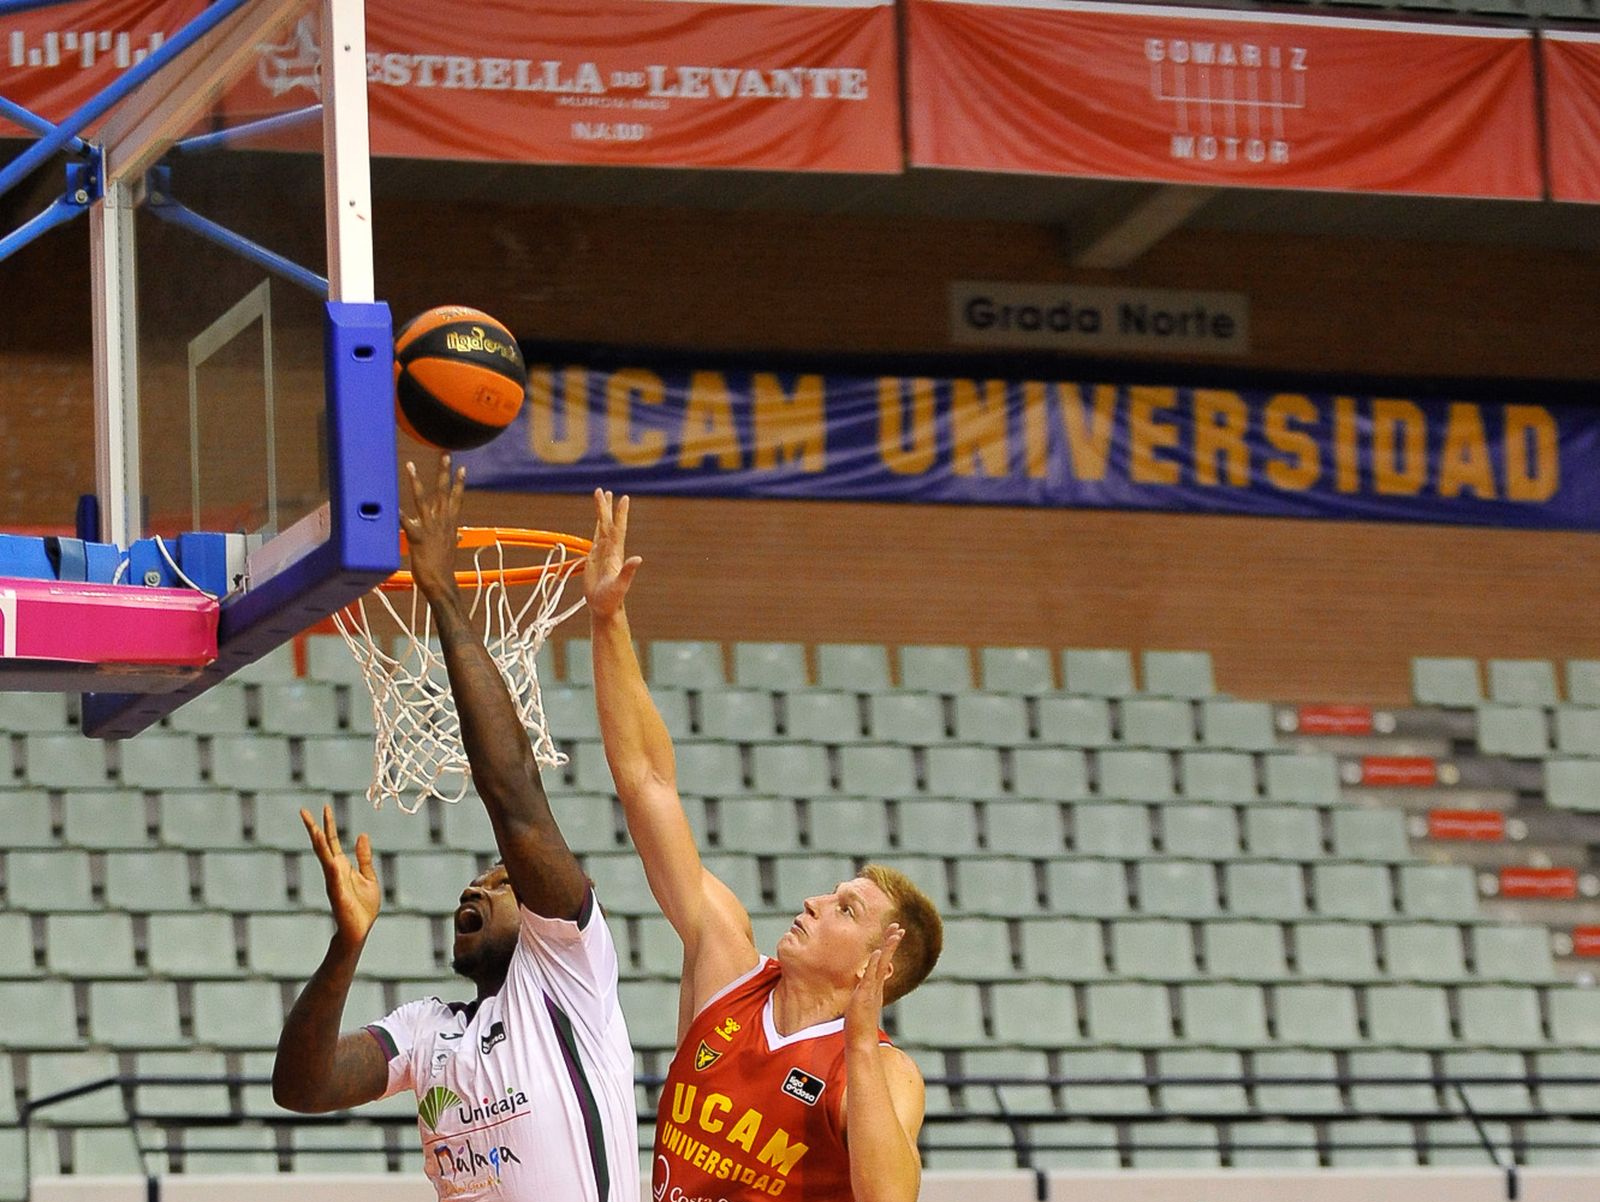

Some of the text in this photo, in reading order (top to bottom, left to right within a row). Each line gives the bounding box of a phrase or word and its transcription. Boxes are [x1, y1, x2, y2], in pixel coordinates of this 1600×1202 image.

[366, 53, 608, 94] ESTRELLA
[647, 65, 868, 99] LEVANTE
[1171, 135, 1289, 164] MOTOR
[964, 296, 1235, 338] Grada Norte
[528, 364, 1560, 503] UCAM UNIVERSIDAD
[459, 1087, 529, 1124] Unicaja
[671, 1082, 809, 1177] UCAM
[661, 1121, 787, 1197] UNIVERSIDAD
